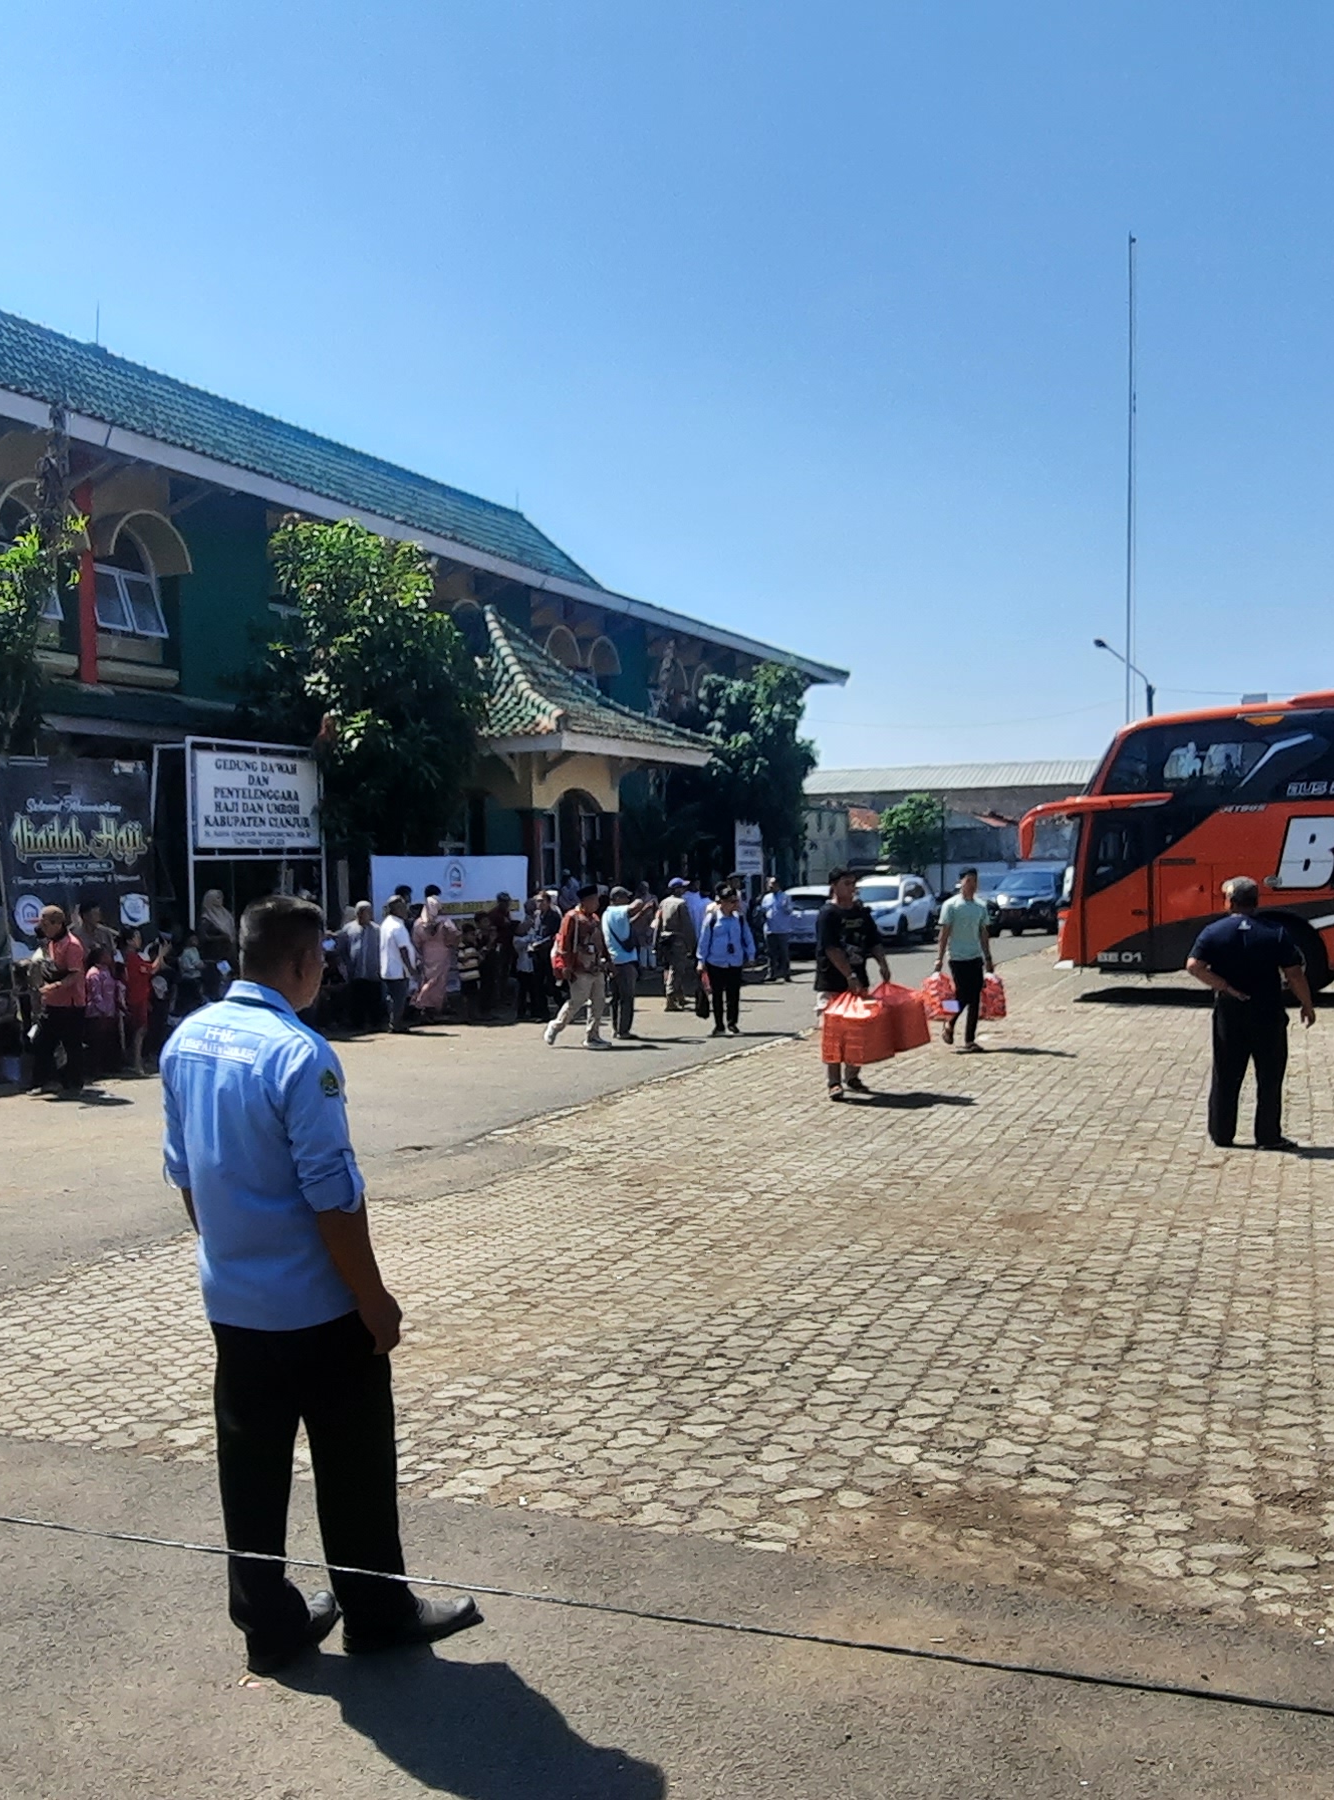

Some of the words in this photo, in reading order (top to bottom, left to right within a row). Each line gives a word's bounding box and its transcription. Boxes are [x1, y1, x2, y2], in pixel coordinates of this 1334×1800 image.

[215, 759, 257, 772] GEDUNG
[248, 775, 269, 786] DAN
[213, 787, 299, 801] PENYELENGGARA
[1286, 780, 1327, 796] BUS
[214, 801, 239, 813] HAJI
[242, 802, 264, 814] DAN
[203, 815, 265, 827] KABUPATEN
[268, 817, 310, 828] CIANJUR
[11, 813, 91, 862] Ibadah
[91, 815, 148, 865] Haji
[1121, 951, 1143, 963] 01
